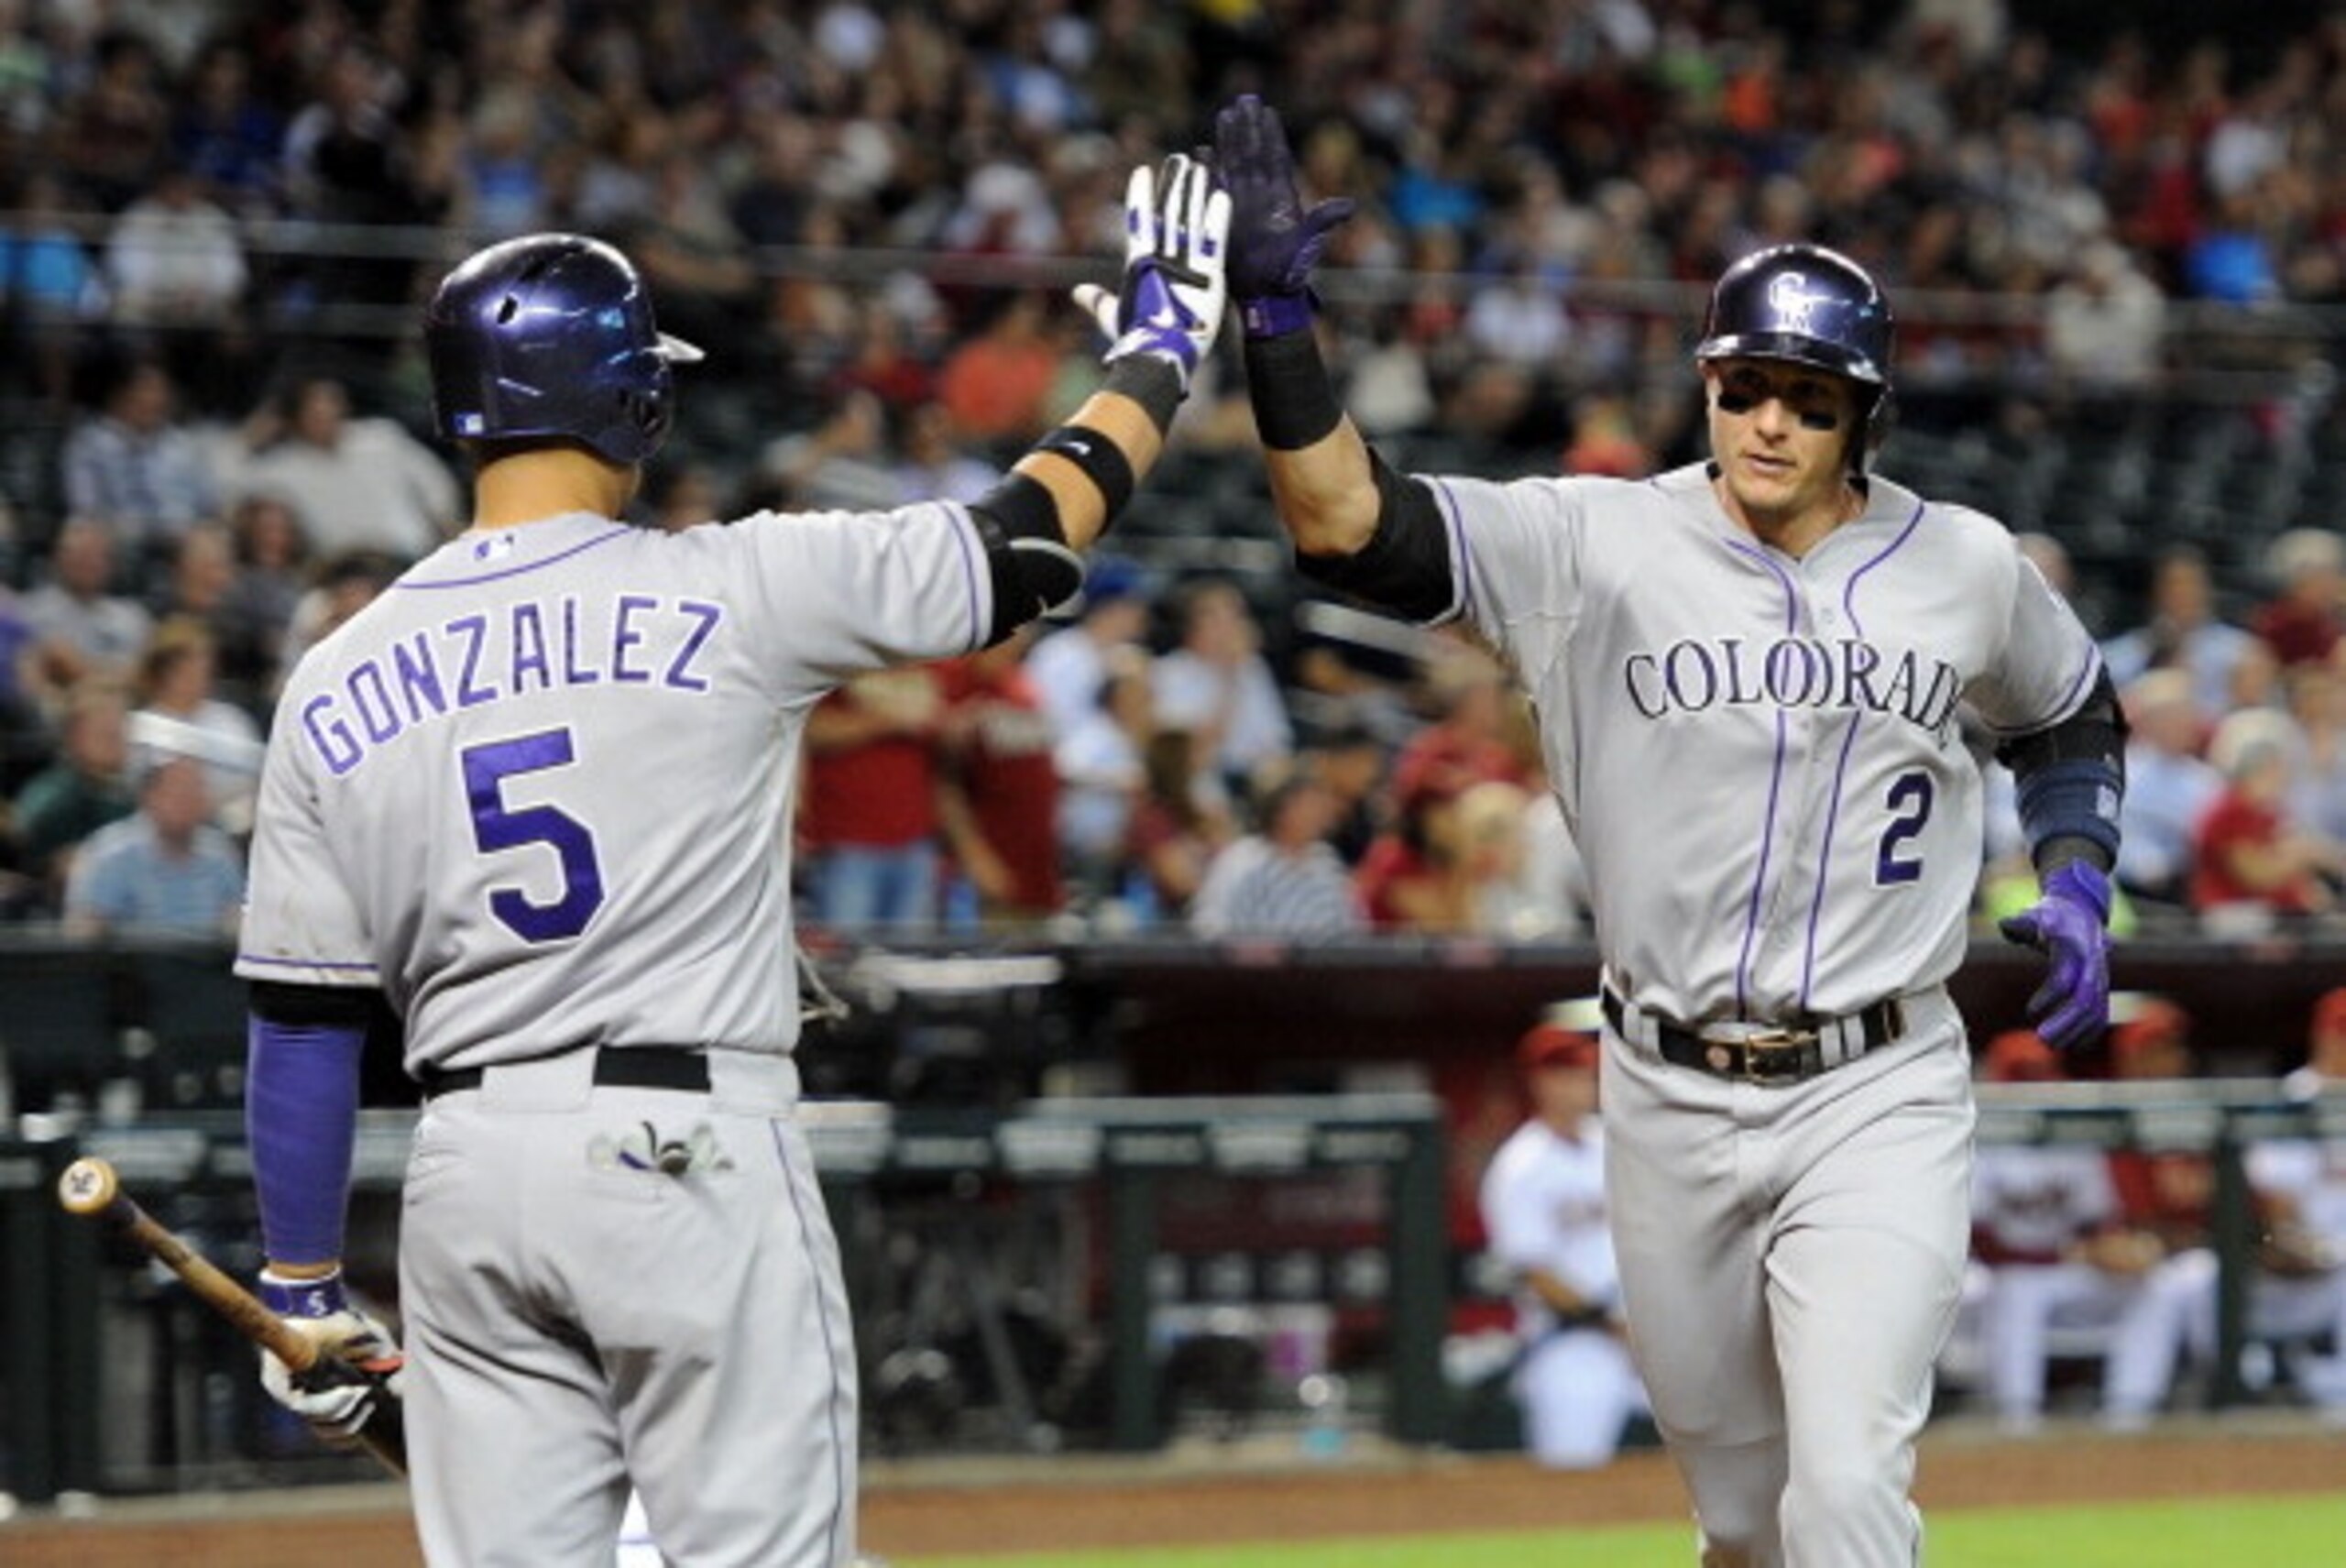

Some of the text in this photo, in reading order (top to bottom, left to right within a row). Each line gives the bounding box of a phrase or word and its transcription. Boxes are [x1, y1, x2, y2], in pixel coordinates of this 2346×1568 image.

[301, 594, 723, 776] GONZALEZ
[461, 727, 606, 944] 5
[1876, 772, 1934, 885] 2
